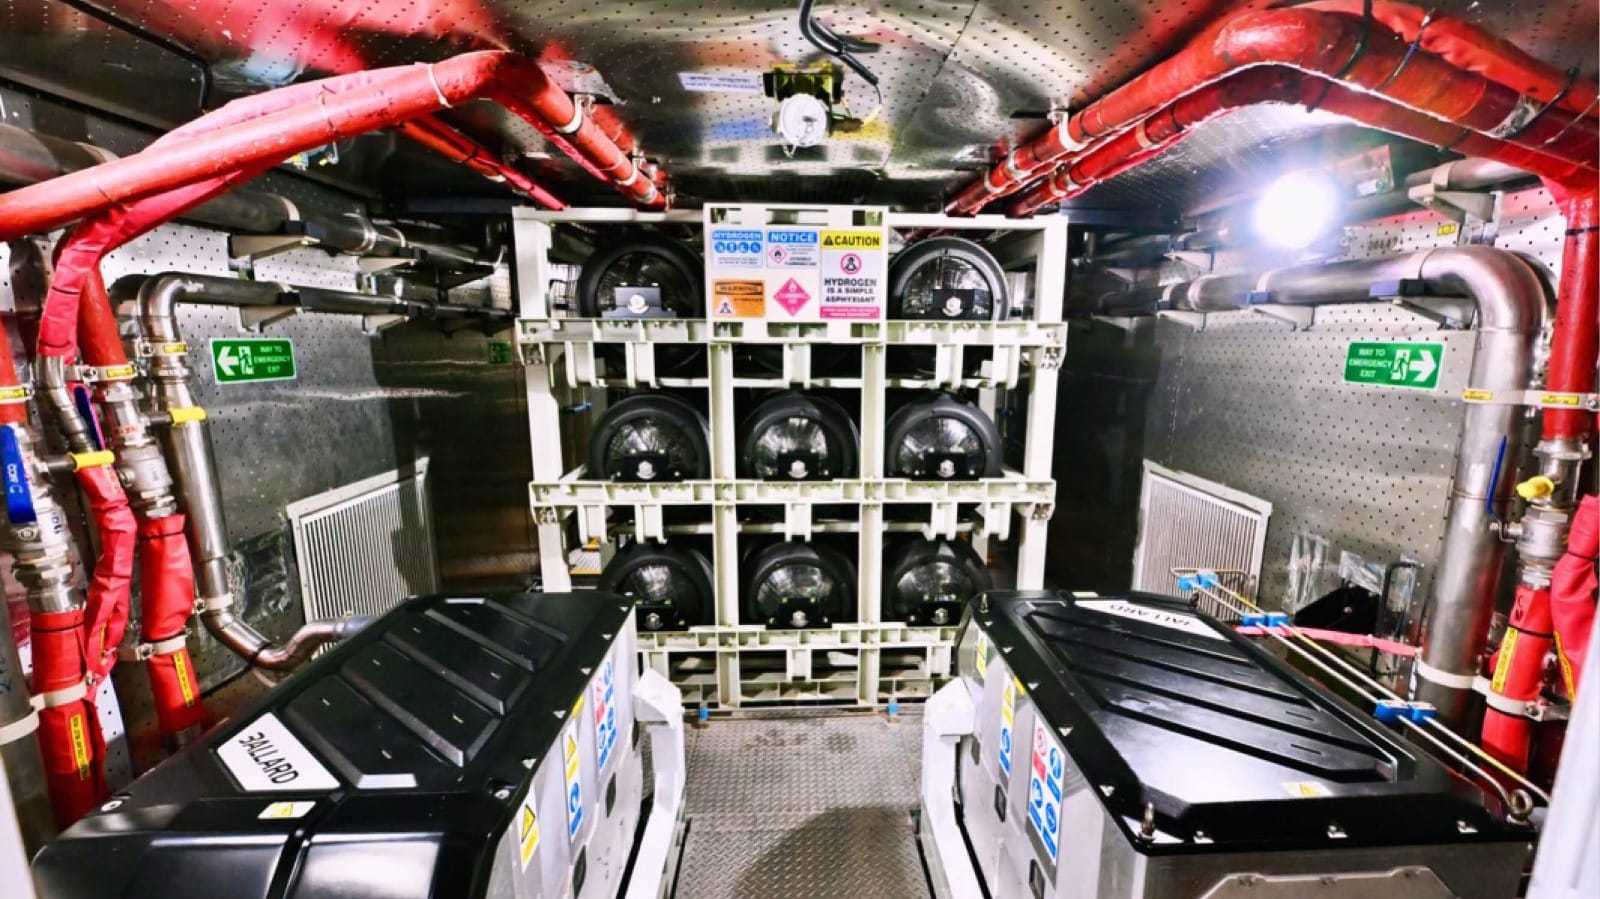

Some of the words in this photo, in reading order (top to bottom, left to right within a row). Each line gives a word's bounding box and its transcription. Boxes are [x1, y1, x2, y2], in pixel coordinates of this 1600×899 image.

[771, 231, 815, 242] NOTICE
[834, 235, 880, 247] CAUTION
[824, 278, 876, 287] HYDROGEN
[1358, 348, 1374, 357] WAY
[1375, 348, 1386, 357] TO
[1348, 358, 1393, 368] EMERGENCY
[1359, 369, 1377, 378] EXIT
